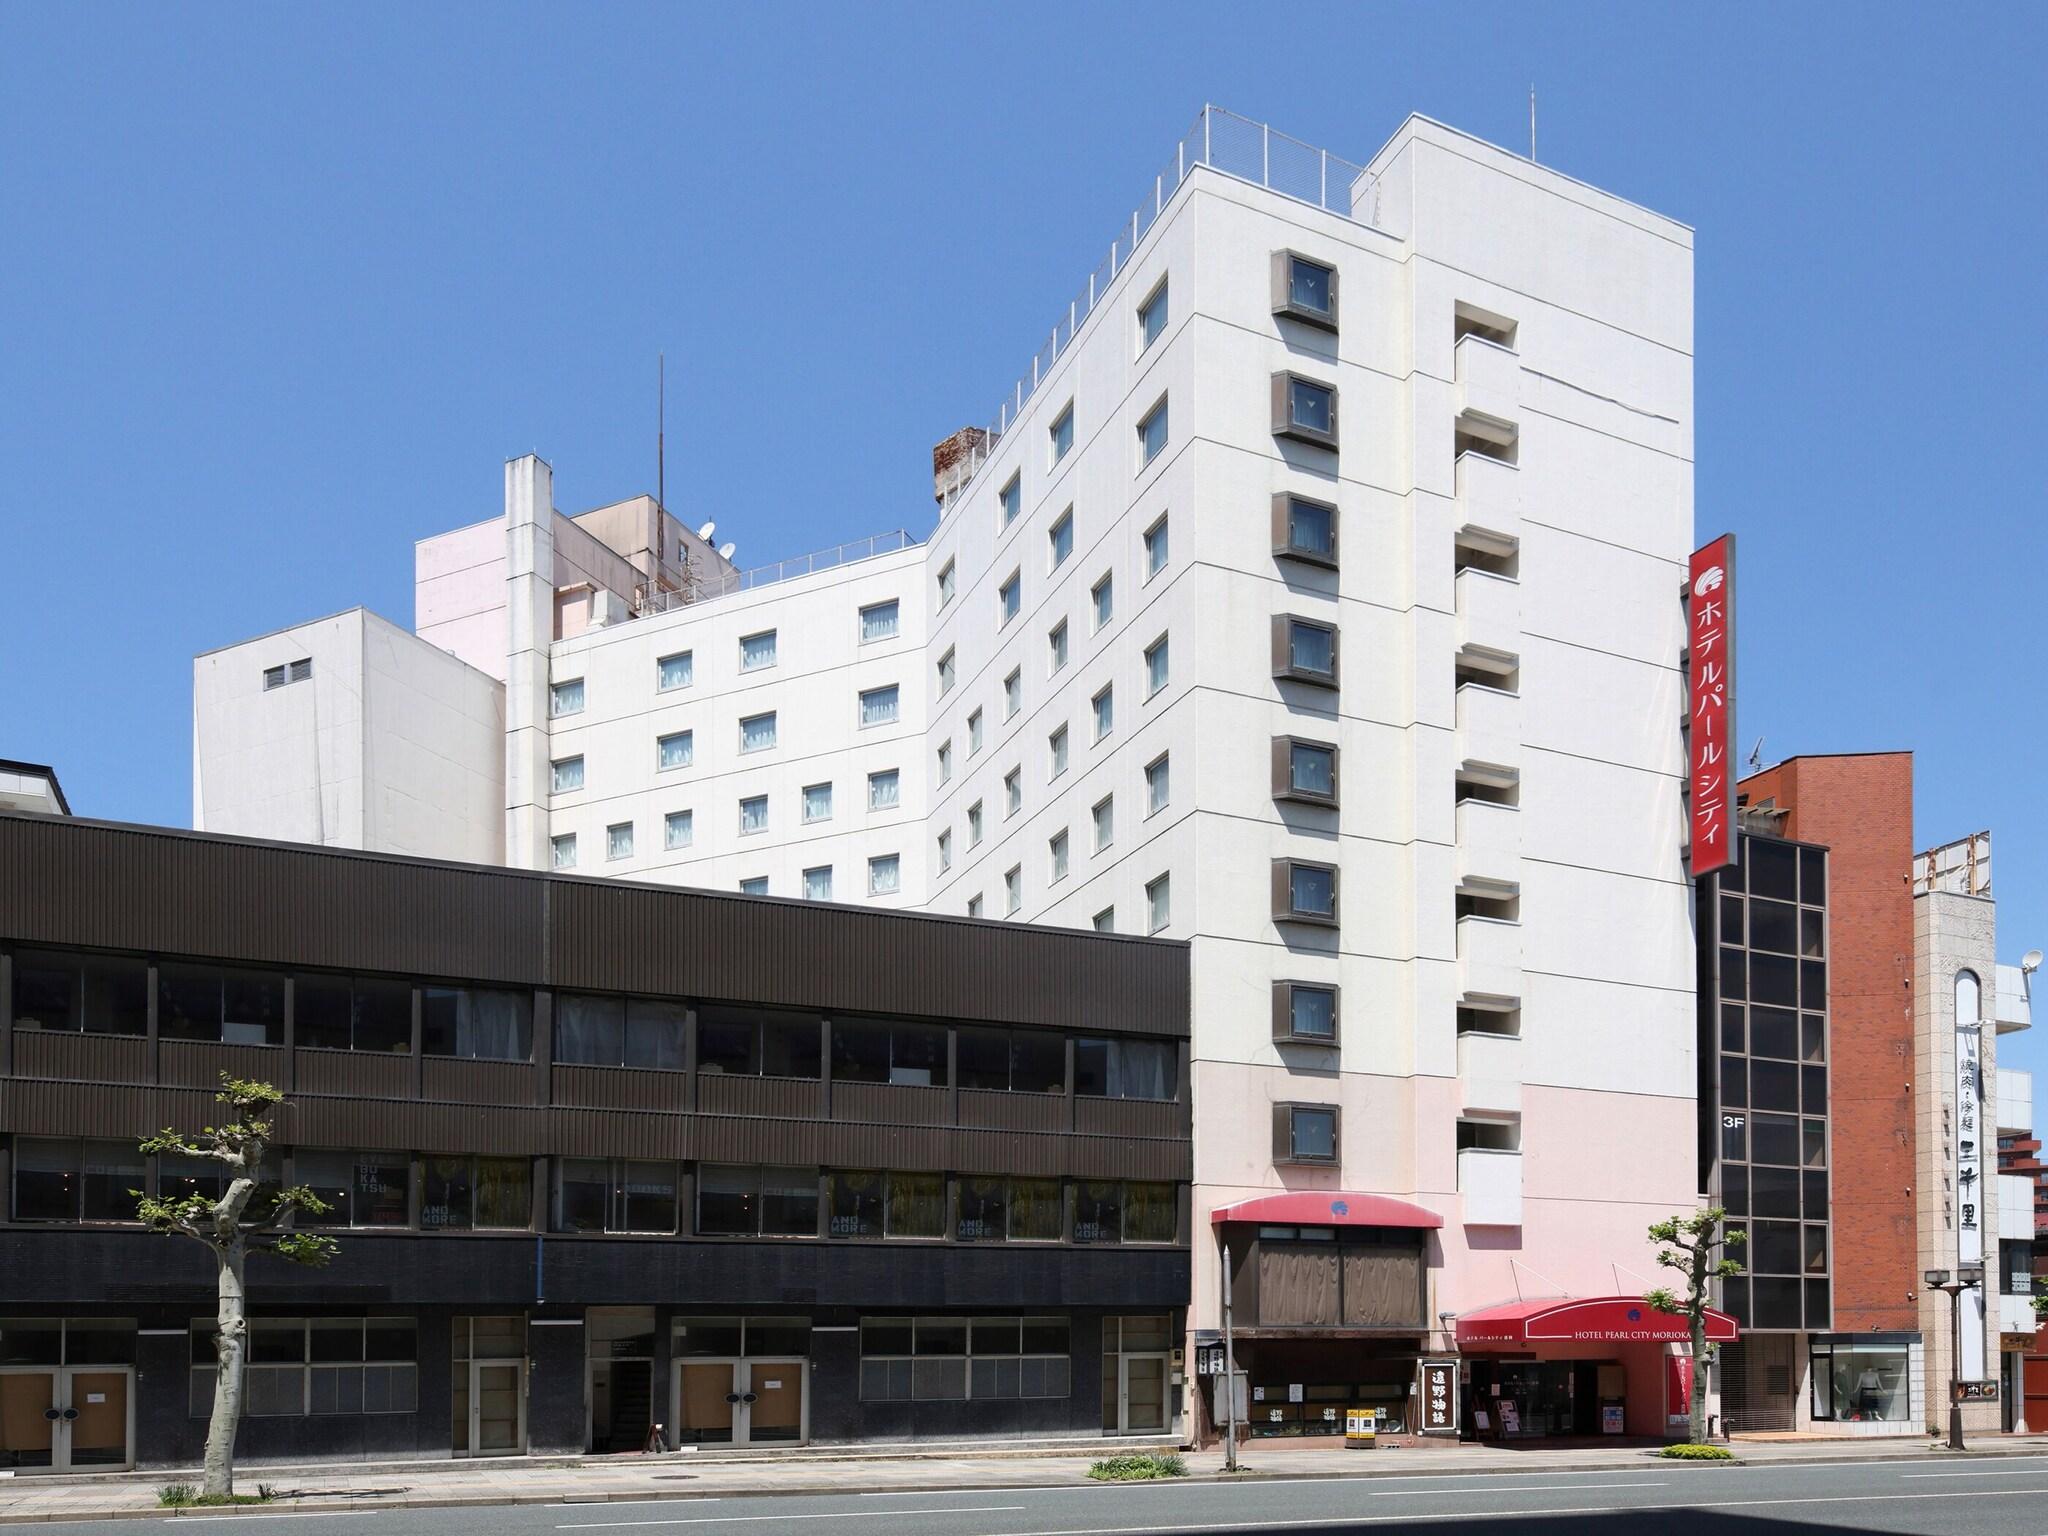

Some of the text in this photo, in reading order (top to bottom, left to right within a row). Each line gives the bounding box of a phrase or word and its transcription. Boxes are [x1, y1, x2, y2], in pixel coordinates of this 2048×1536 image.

[1695, 600, 1724, 845] ホテルパールシティ
[1723, 1116, 1745, 1128] 3F
[1575, 1331, 1692, 1339] HOTEL PEARL CITY MORIOKA
